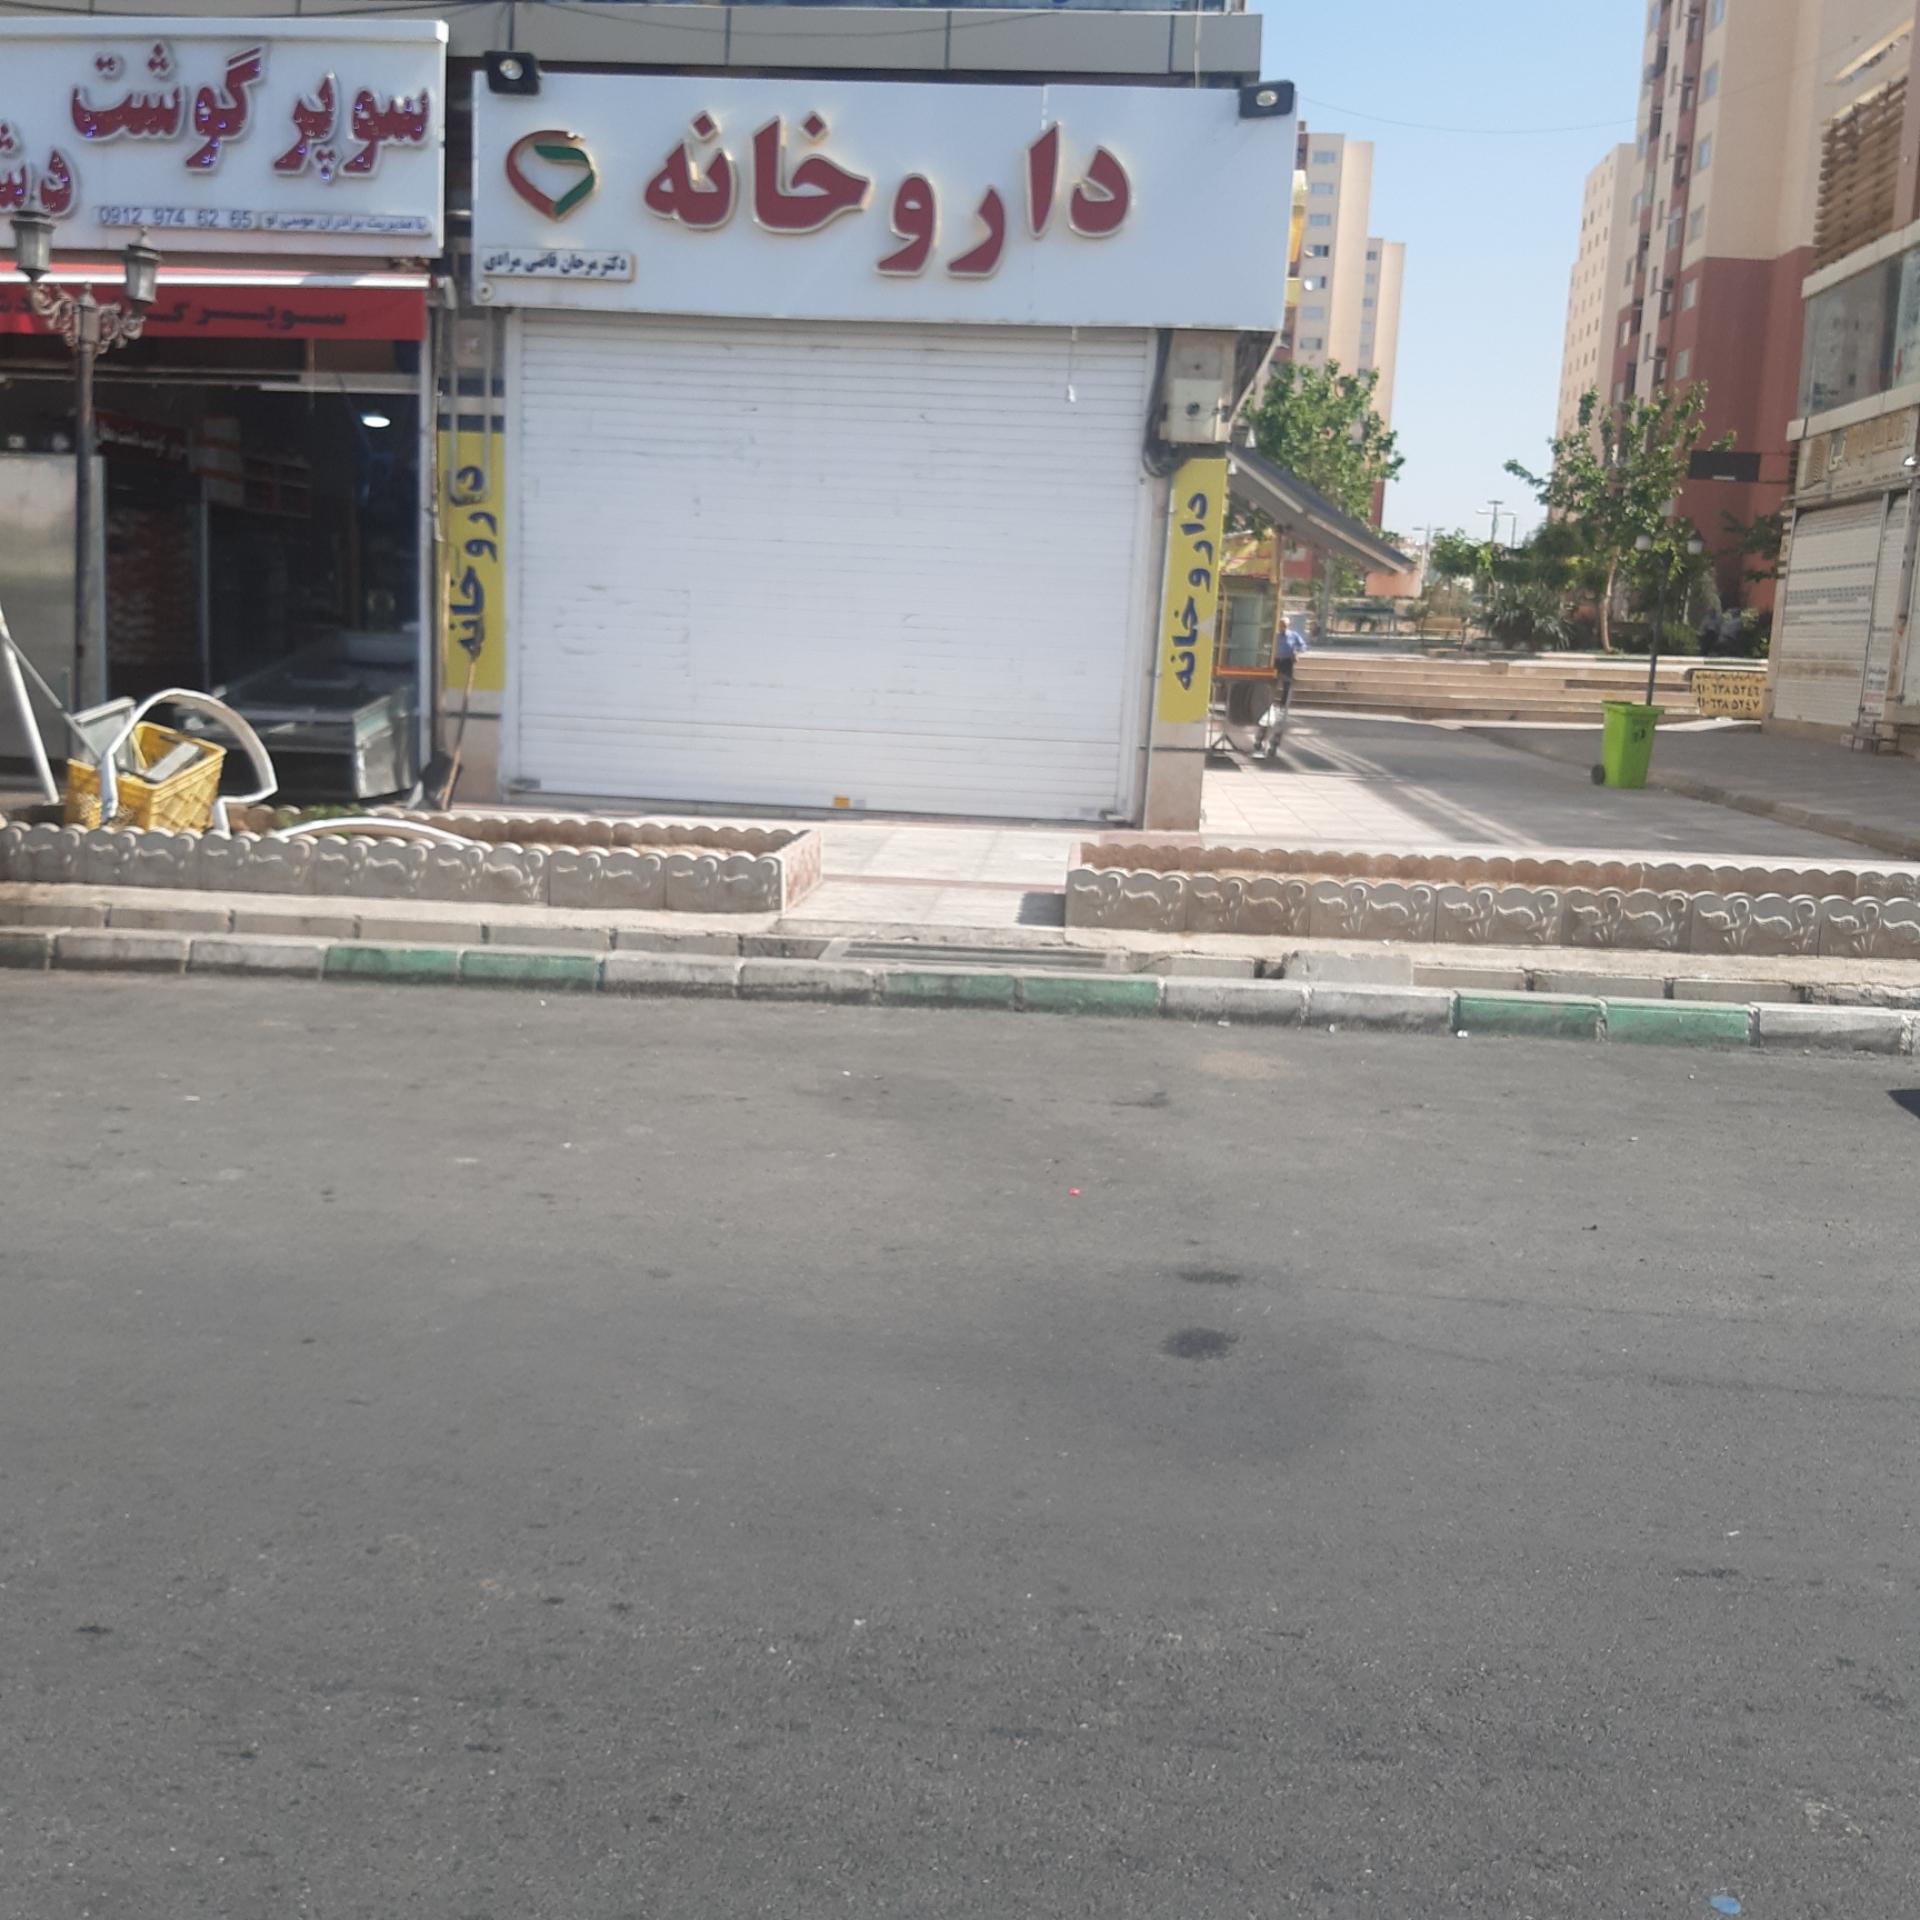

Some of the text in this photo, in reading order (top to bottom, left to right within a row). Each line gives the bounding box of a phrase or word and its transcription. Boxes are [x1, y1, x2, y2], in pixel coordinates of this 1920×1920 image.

[71, 43, 430, 182] سوپر گوشت
[100, 206, 142, 225] 0912
[153, 207, 185, 226] 974
[600, 254, 627, 277] دکتر
[645, 111, 1133, 277] داروخانه
[450, 465, 498, 662] داروخانه
[1170, 492, 1213, 690] داروخانه
